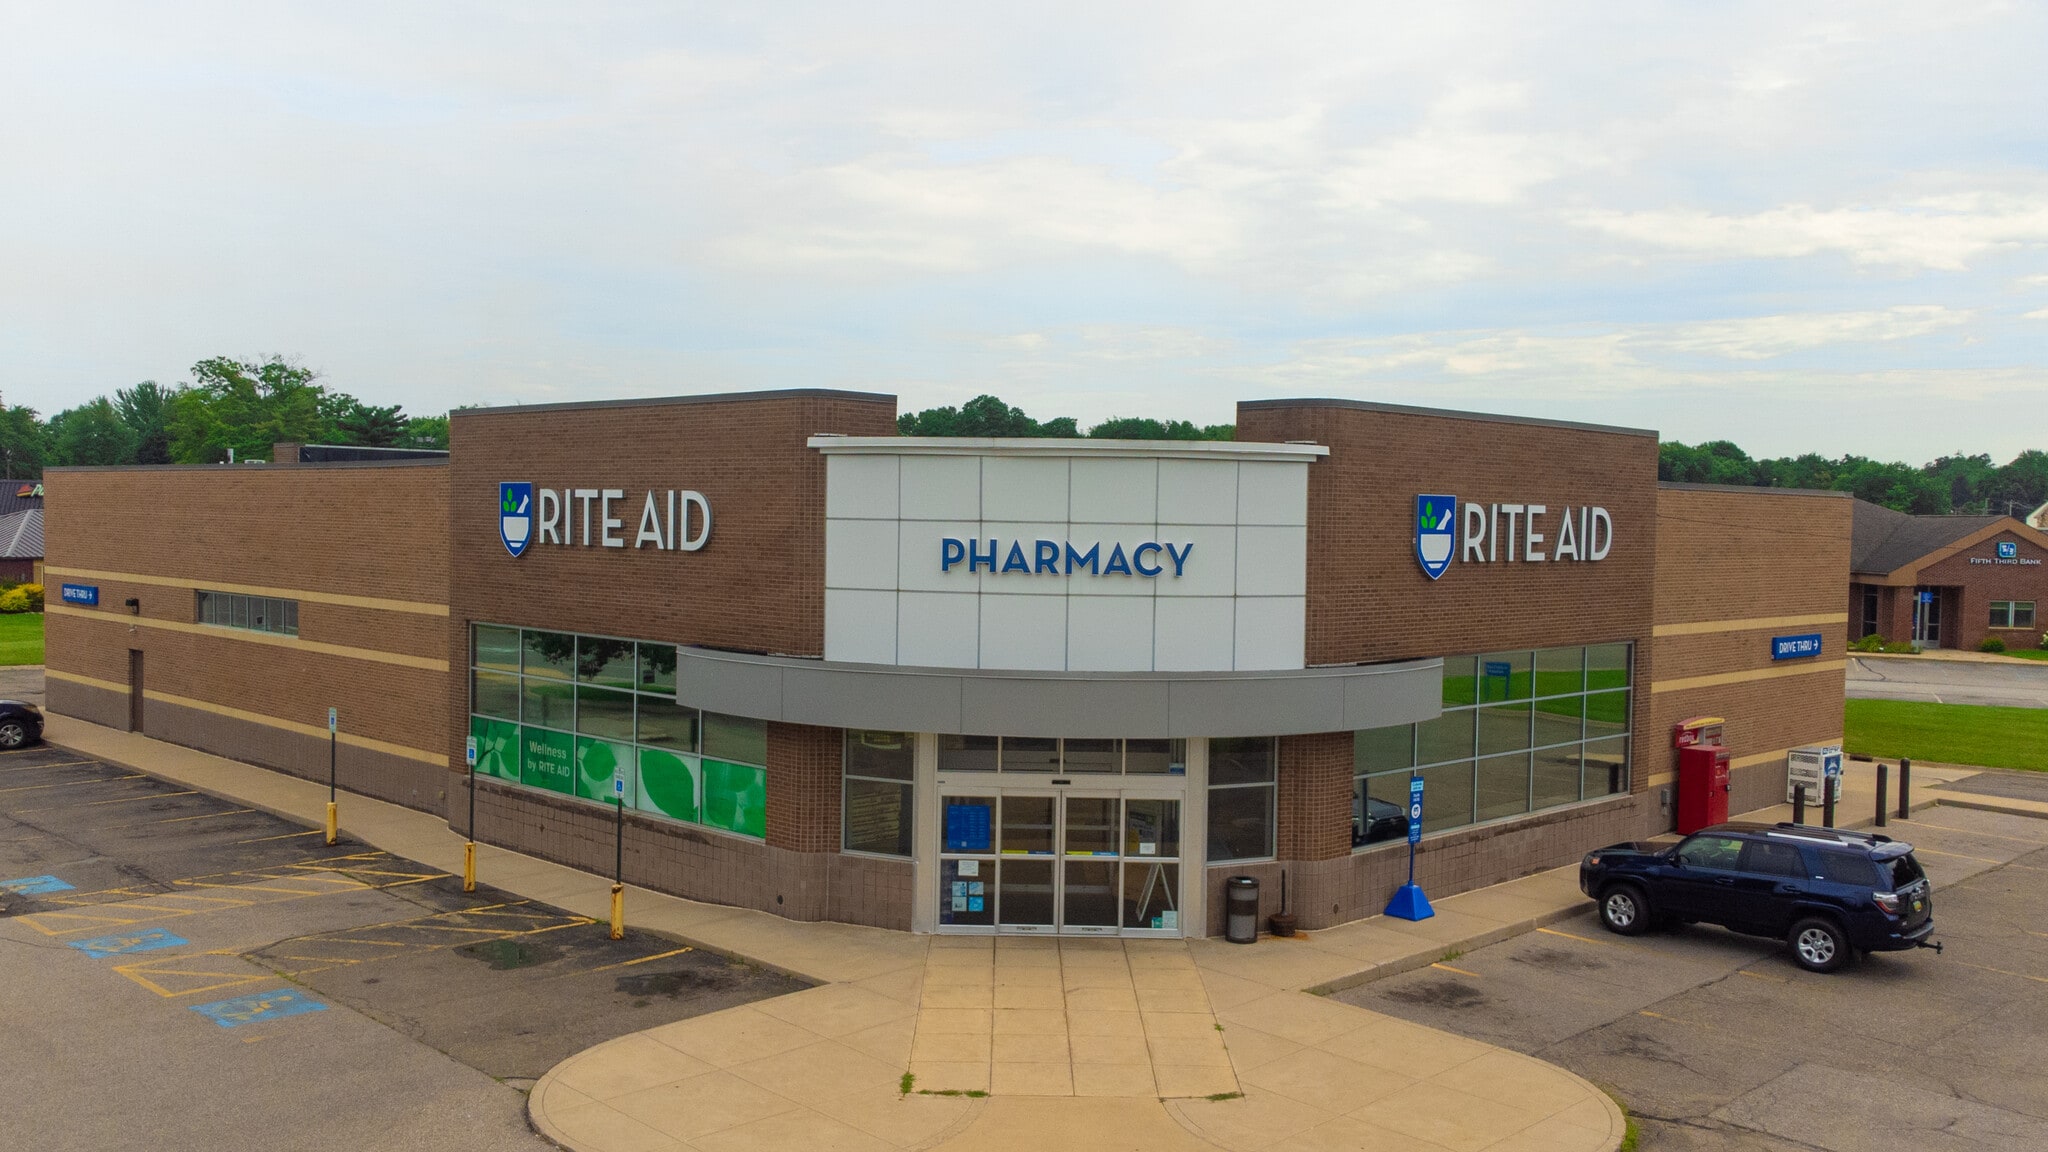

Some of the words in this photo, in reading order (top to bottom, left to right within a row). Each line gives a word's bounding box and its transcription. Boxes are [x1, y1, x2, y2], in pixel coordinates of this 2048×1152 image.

[539, 488, 624, 548] RITE
[634, 489, 711, 551] AID
[1462, 502, 1547, 563] RITE
[1554, 504, 1613, 562] AID
[941, 537, 1194, 578] PHARMACY
[1970, 557, 1992, 565] FIFTH
[1779, 641, 1797, 654] DRIVE
[1797, 640, 1813, 652] THRU
[529, 740, 567, 759] Wellness
[528, 758, 537, 772] by
[538, 760, 555, 774] RITE
[557, 766, 570, 778] AID
